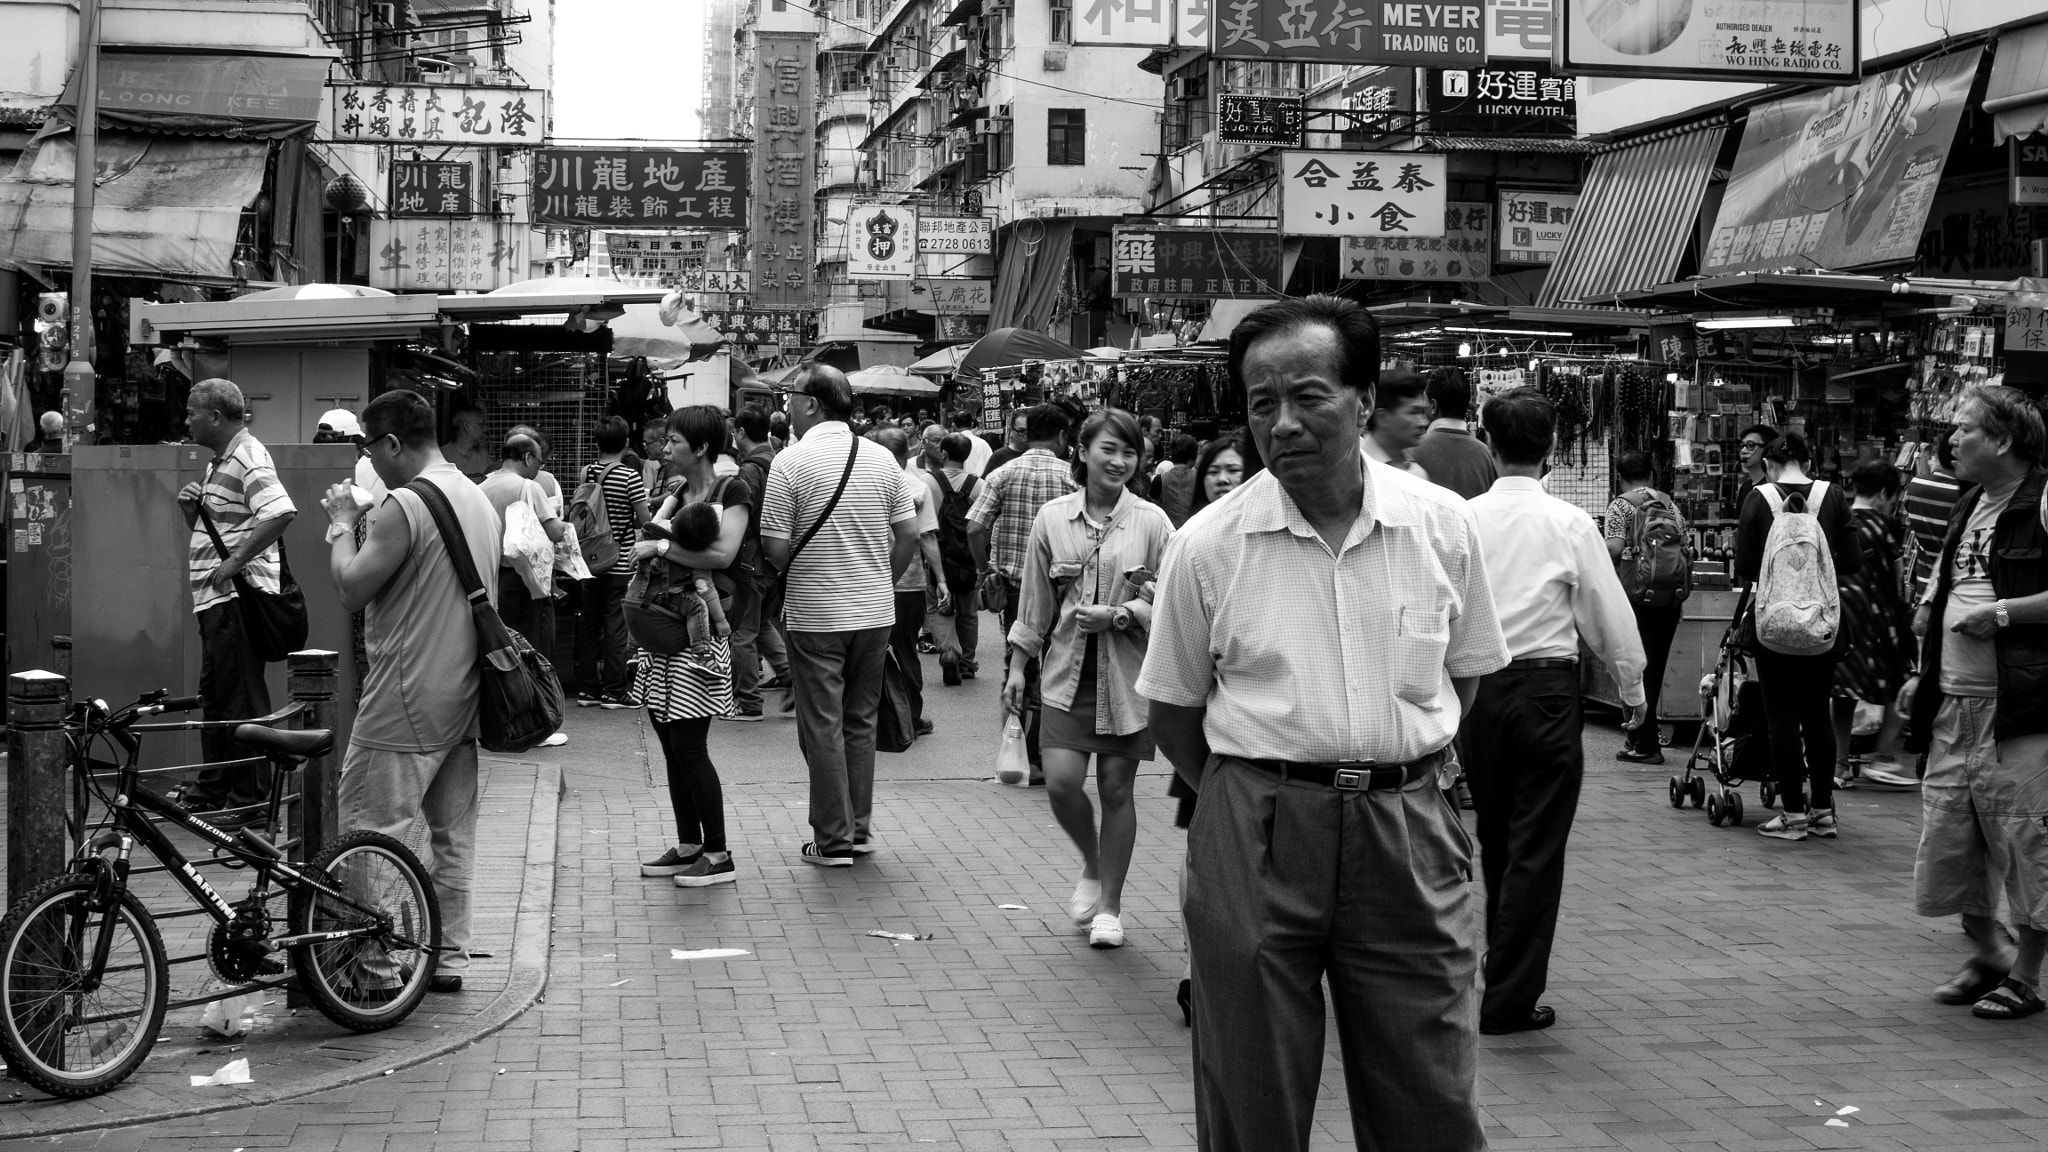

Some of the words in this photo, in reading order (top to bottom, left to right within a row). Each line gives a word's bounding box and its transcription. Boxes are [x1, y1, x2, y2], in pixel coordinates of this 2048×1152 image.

[1383, 2, 1480, 29] MEYER
[1715, 22, 1750, 32] AUTHORISED
[1751, 23, 1773, 33] DEALER
[1383, 33, 1448, 53] TRADING
[1456, 36, 1480, 54] CO.
[1725, 35, 1842, 59] 和興無線電行
[1726, 55, 1745, 66] WO
[1748, 56, 1779, 67] HING
[1783, 58, 1819, 69] RADIO
[1822, 59, 1842, 70] CO.
[1869, 93, 1905, 161] Energizer
[399, 165, 466, 190] 川龍
[541, 155, 736, 192] 川龍地產
[399, 191, 464, 213] 地產
[541, 194, 736, 218] 川龍裝飾工程
[919, 220, 990, 234] 聯邦地產公司
[1314, 201, 1418, 231] 小食
[930, 238, 959, 249] 2728
[962, 238, 990, 249] 0613
[1536, 231, 1562, 239] LUCKY
[611, 249, 641, 257] Charming
[872, 237, 890, 256] 押
[1118, 233, 1155, 274] 藥
[929, 286, 986, 304] 豆腐花
[1130, 278, 1194, 293] 政府註冊
[982, 371, 1002, 421] 耳機總匯
[188, 815, 234, 843] ARIZONA
